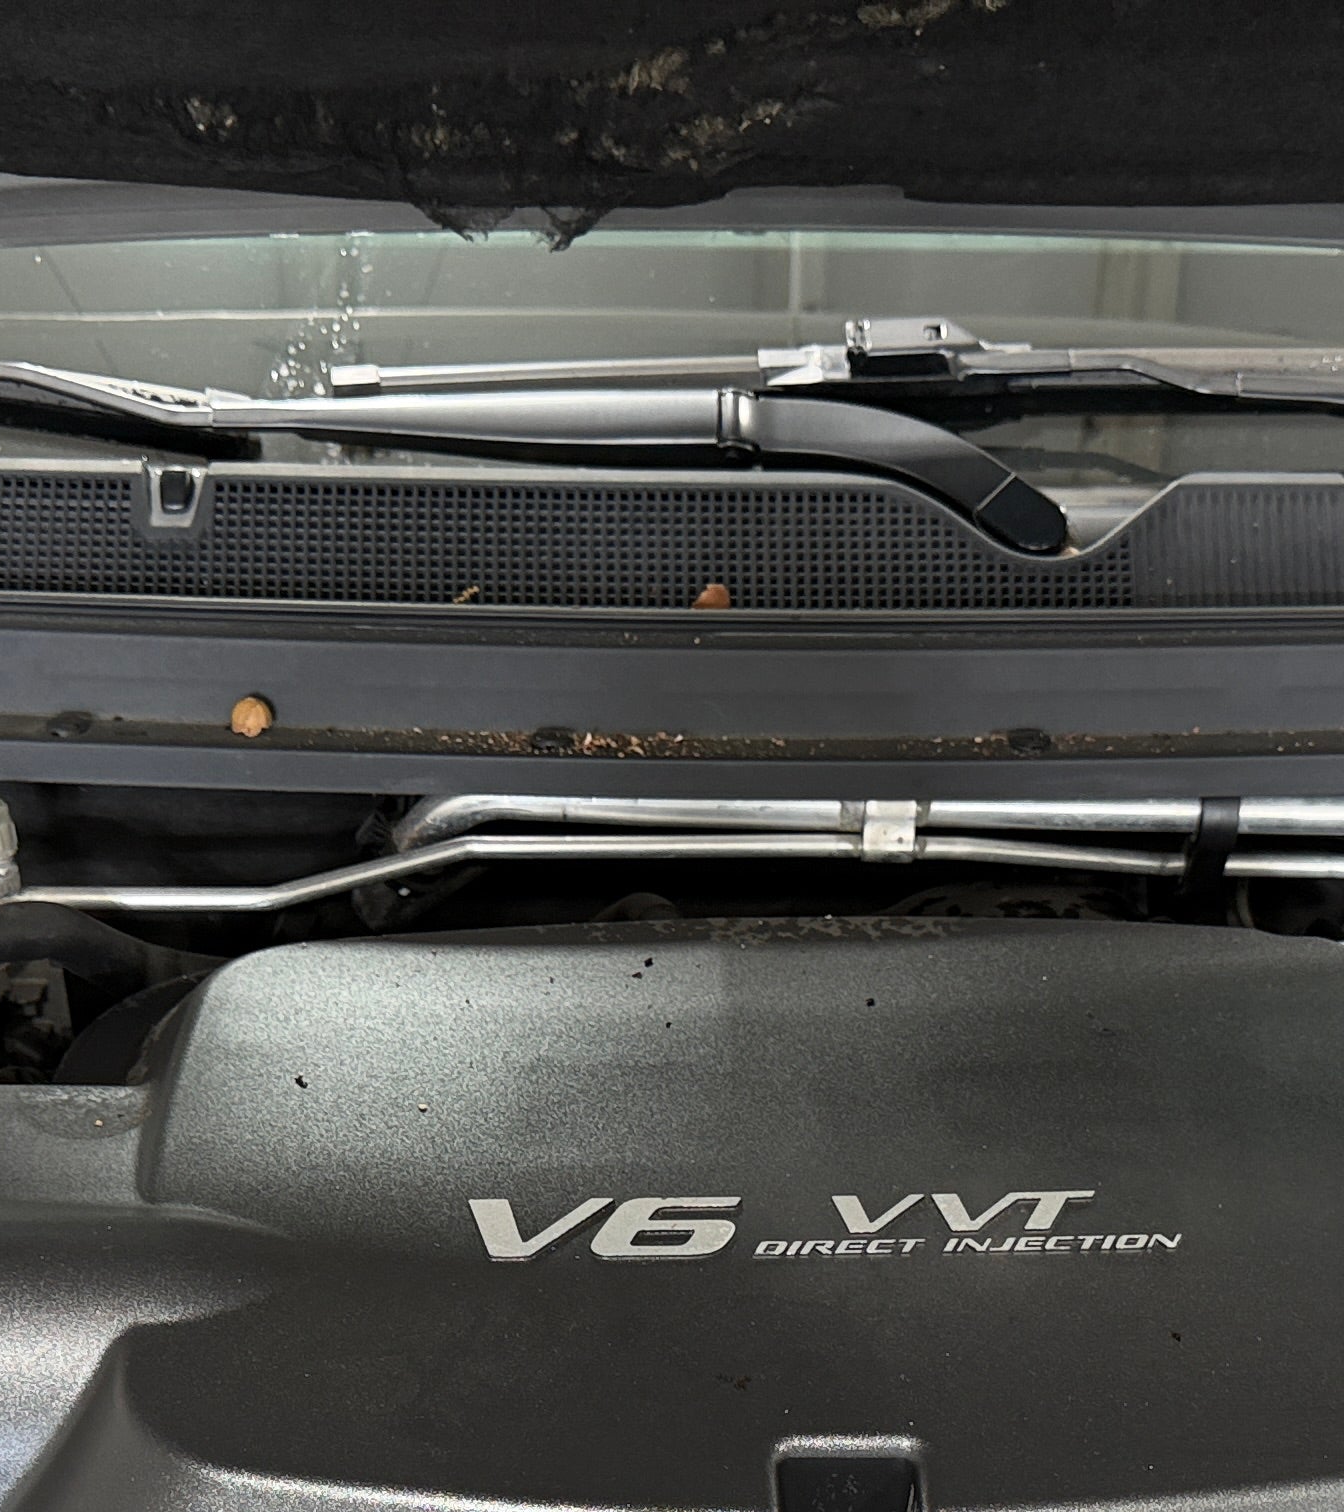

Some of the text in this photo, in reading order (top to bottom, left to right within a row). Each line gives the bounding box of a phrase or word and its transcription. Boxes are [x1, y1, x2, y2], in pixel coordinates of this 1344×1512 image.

[468, 1190, 1095, 1260] V6 VVT
[754, 1232, 1184, 1258] DIRECT INJECTION
